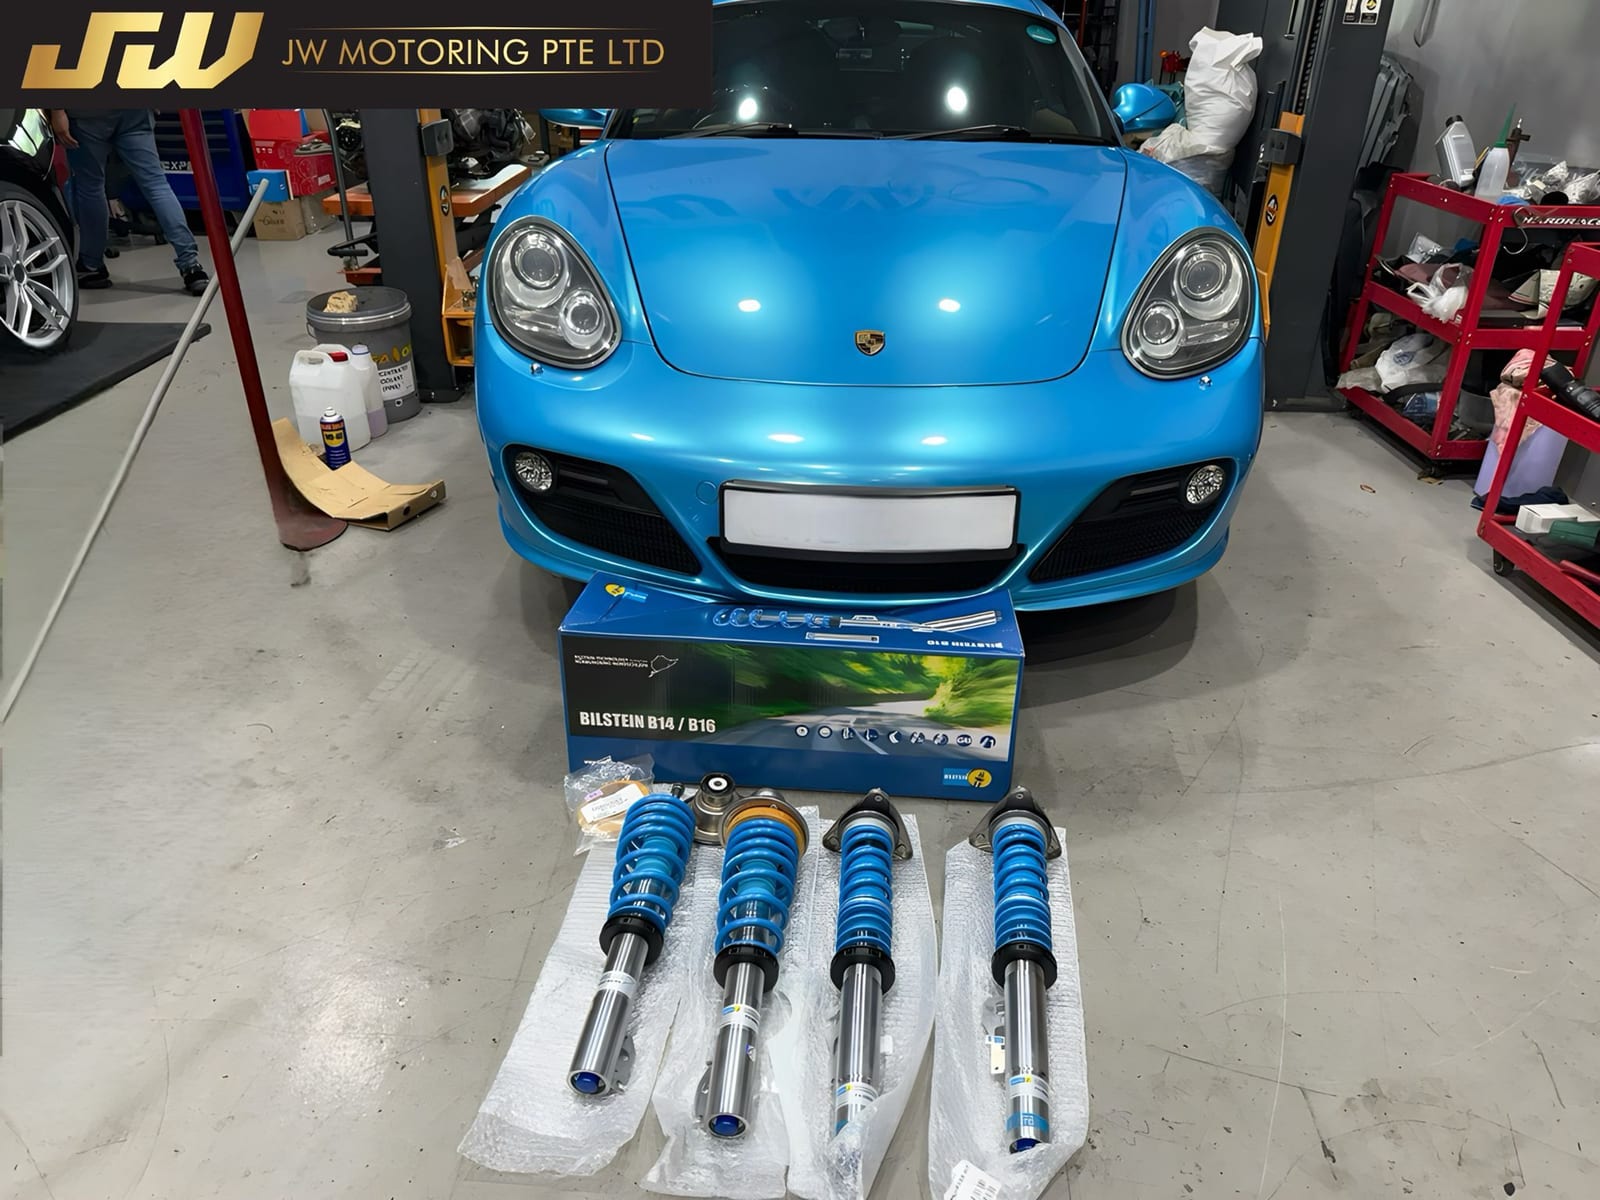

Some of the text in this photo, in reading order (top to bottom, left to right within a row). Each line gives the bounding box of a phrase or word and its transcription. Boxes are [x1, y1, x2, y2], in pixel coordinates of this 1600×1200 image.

[579, 711, 716, 733] BILSTEIN B14 / B16
